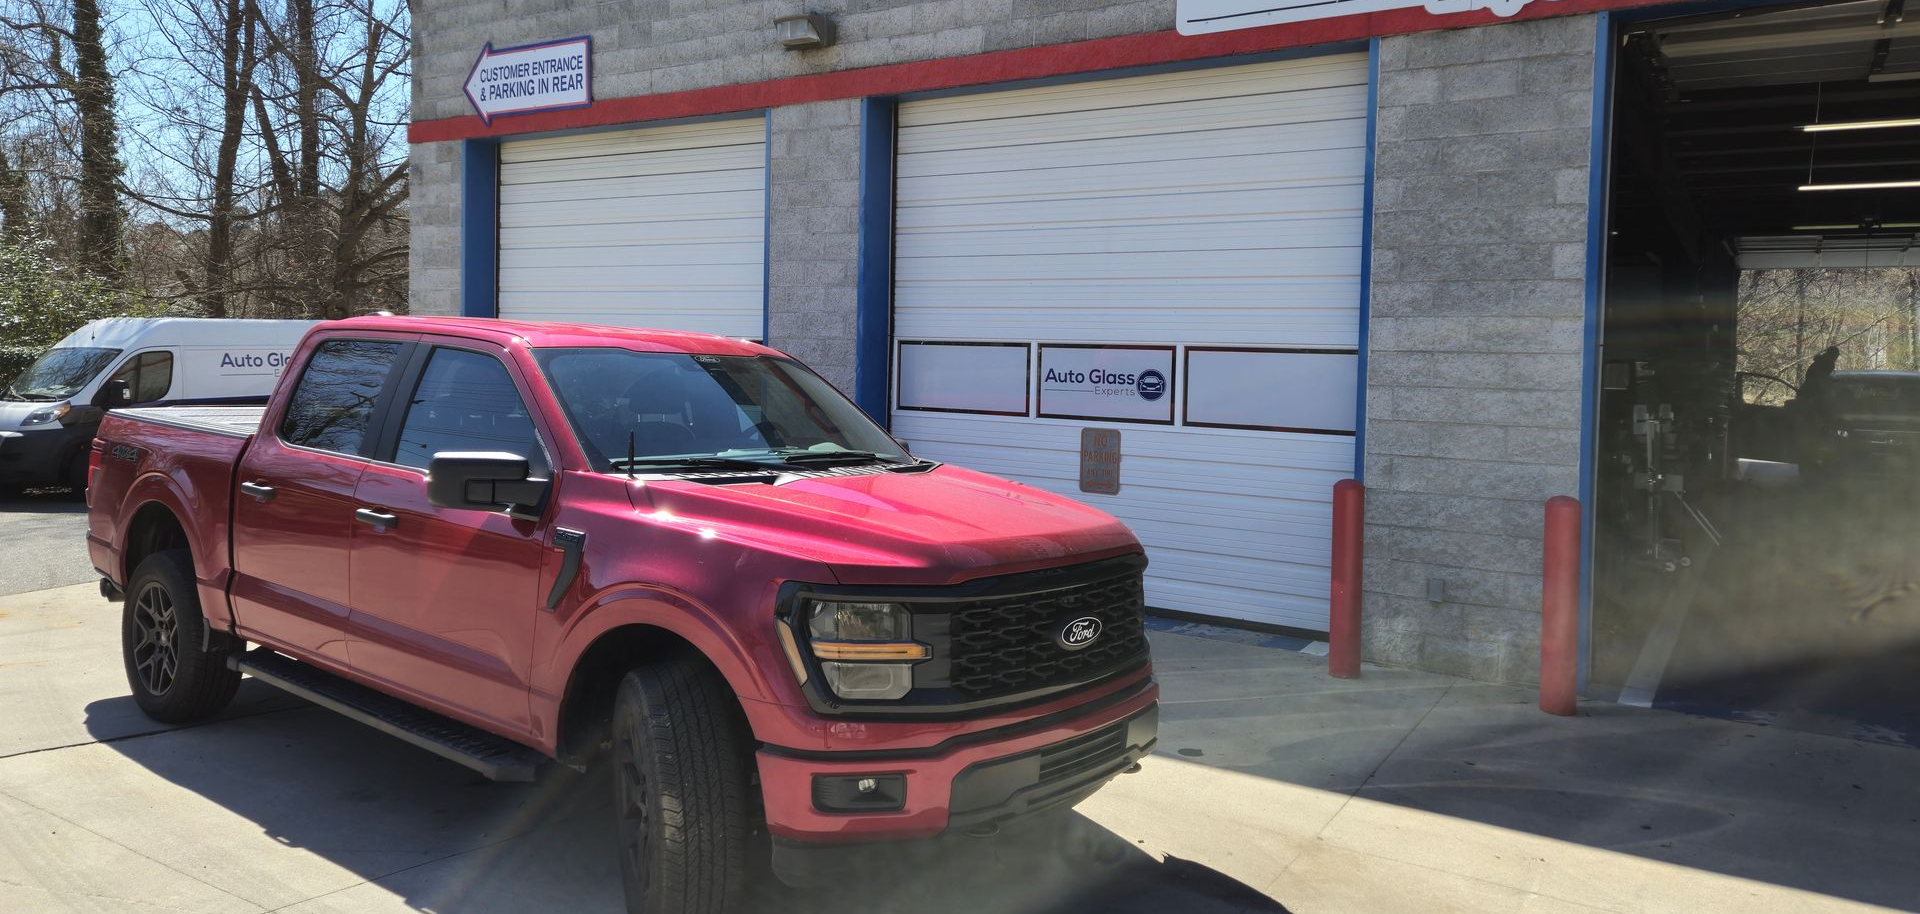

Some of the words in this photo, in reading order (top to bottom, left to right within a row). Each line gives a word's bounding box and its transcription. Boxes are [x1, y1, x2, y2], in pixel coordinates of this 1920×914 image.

[480, 63, 530, 83] CUSTOMER
[532, 55, 582, 76] ENTRANCE
[480, 87, 487, 101] &
[490, 79, 535, 100] PARKING
[538, 77, 549, 94] IN
[553, 73, 583, 92] REAR
[220, 352, 264, 368] Auto
[1044, 368, 1085, 384] Auto
[1089, 369, 1136, 385] Glass
[1094, 386, 1136, 397] Experts
[1094, 433, 1109, 447] NO
[1083, 450, 1118, 465] PARKING
[1070, 621, 1095, 642] Ford
